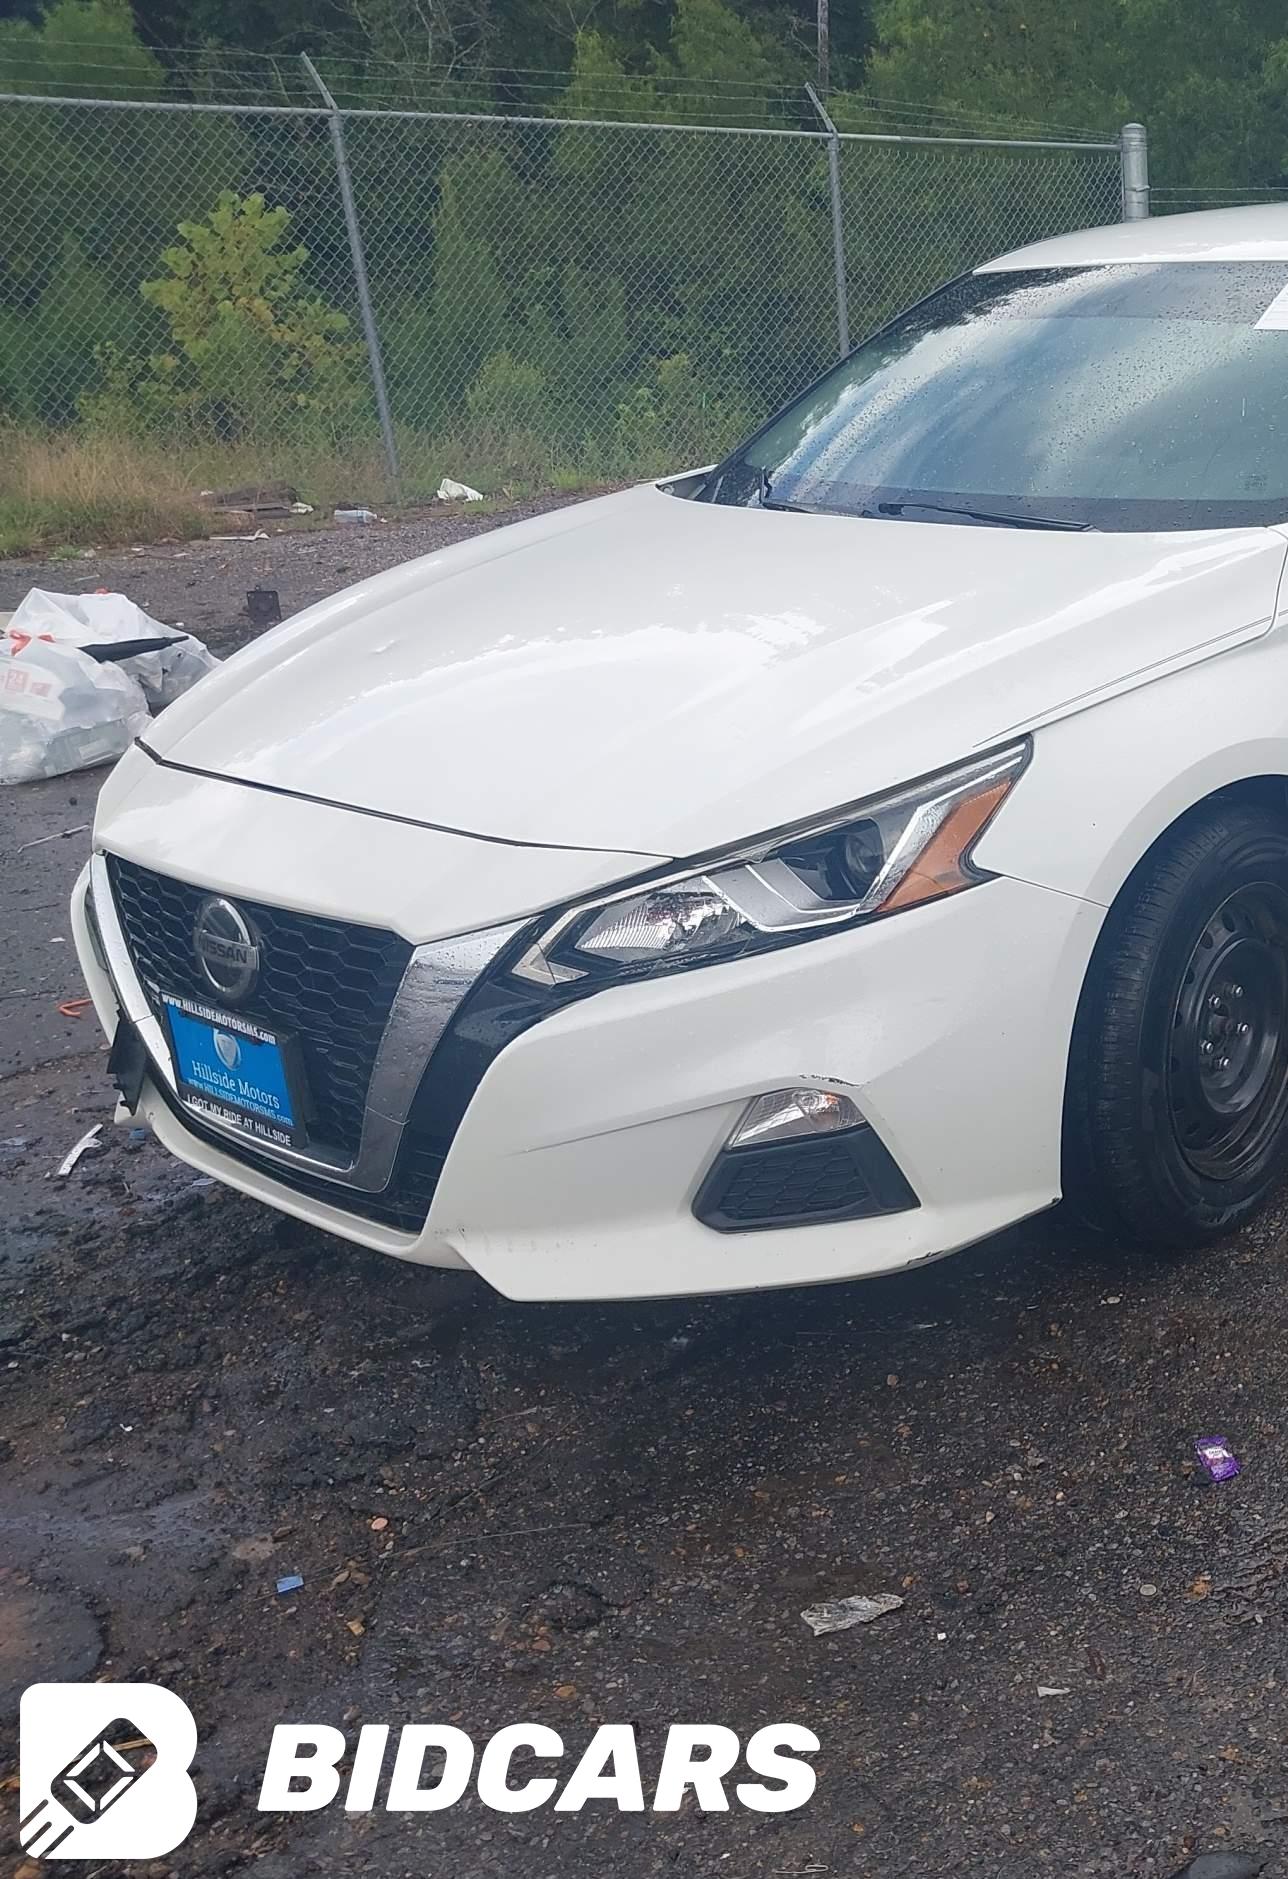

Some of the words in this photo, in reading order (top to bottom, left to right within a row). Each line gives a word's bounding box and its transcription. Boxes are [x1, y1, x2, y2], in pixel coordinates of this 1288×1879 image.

[200, 939, 248, 964] NISSAN
[192, 1060, 236, 1091] Hillside
[238, 1078, 280, 1109] Motors
[191, 1095, 209, 1110] GOT
[210, 1103, 222, 1116] MY
[223, 1109, 242, 1125] RIDE
[243, 1117, 253, 1129] AT
[254, 1121, 292, 1147] HILLSIDE
